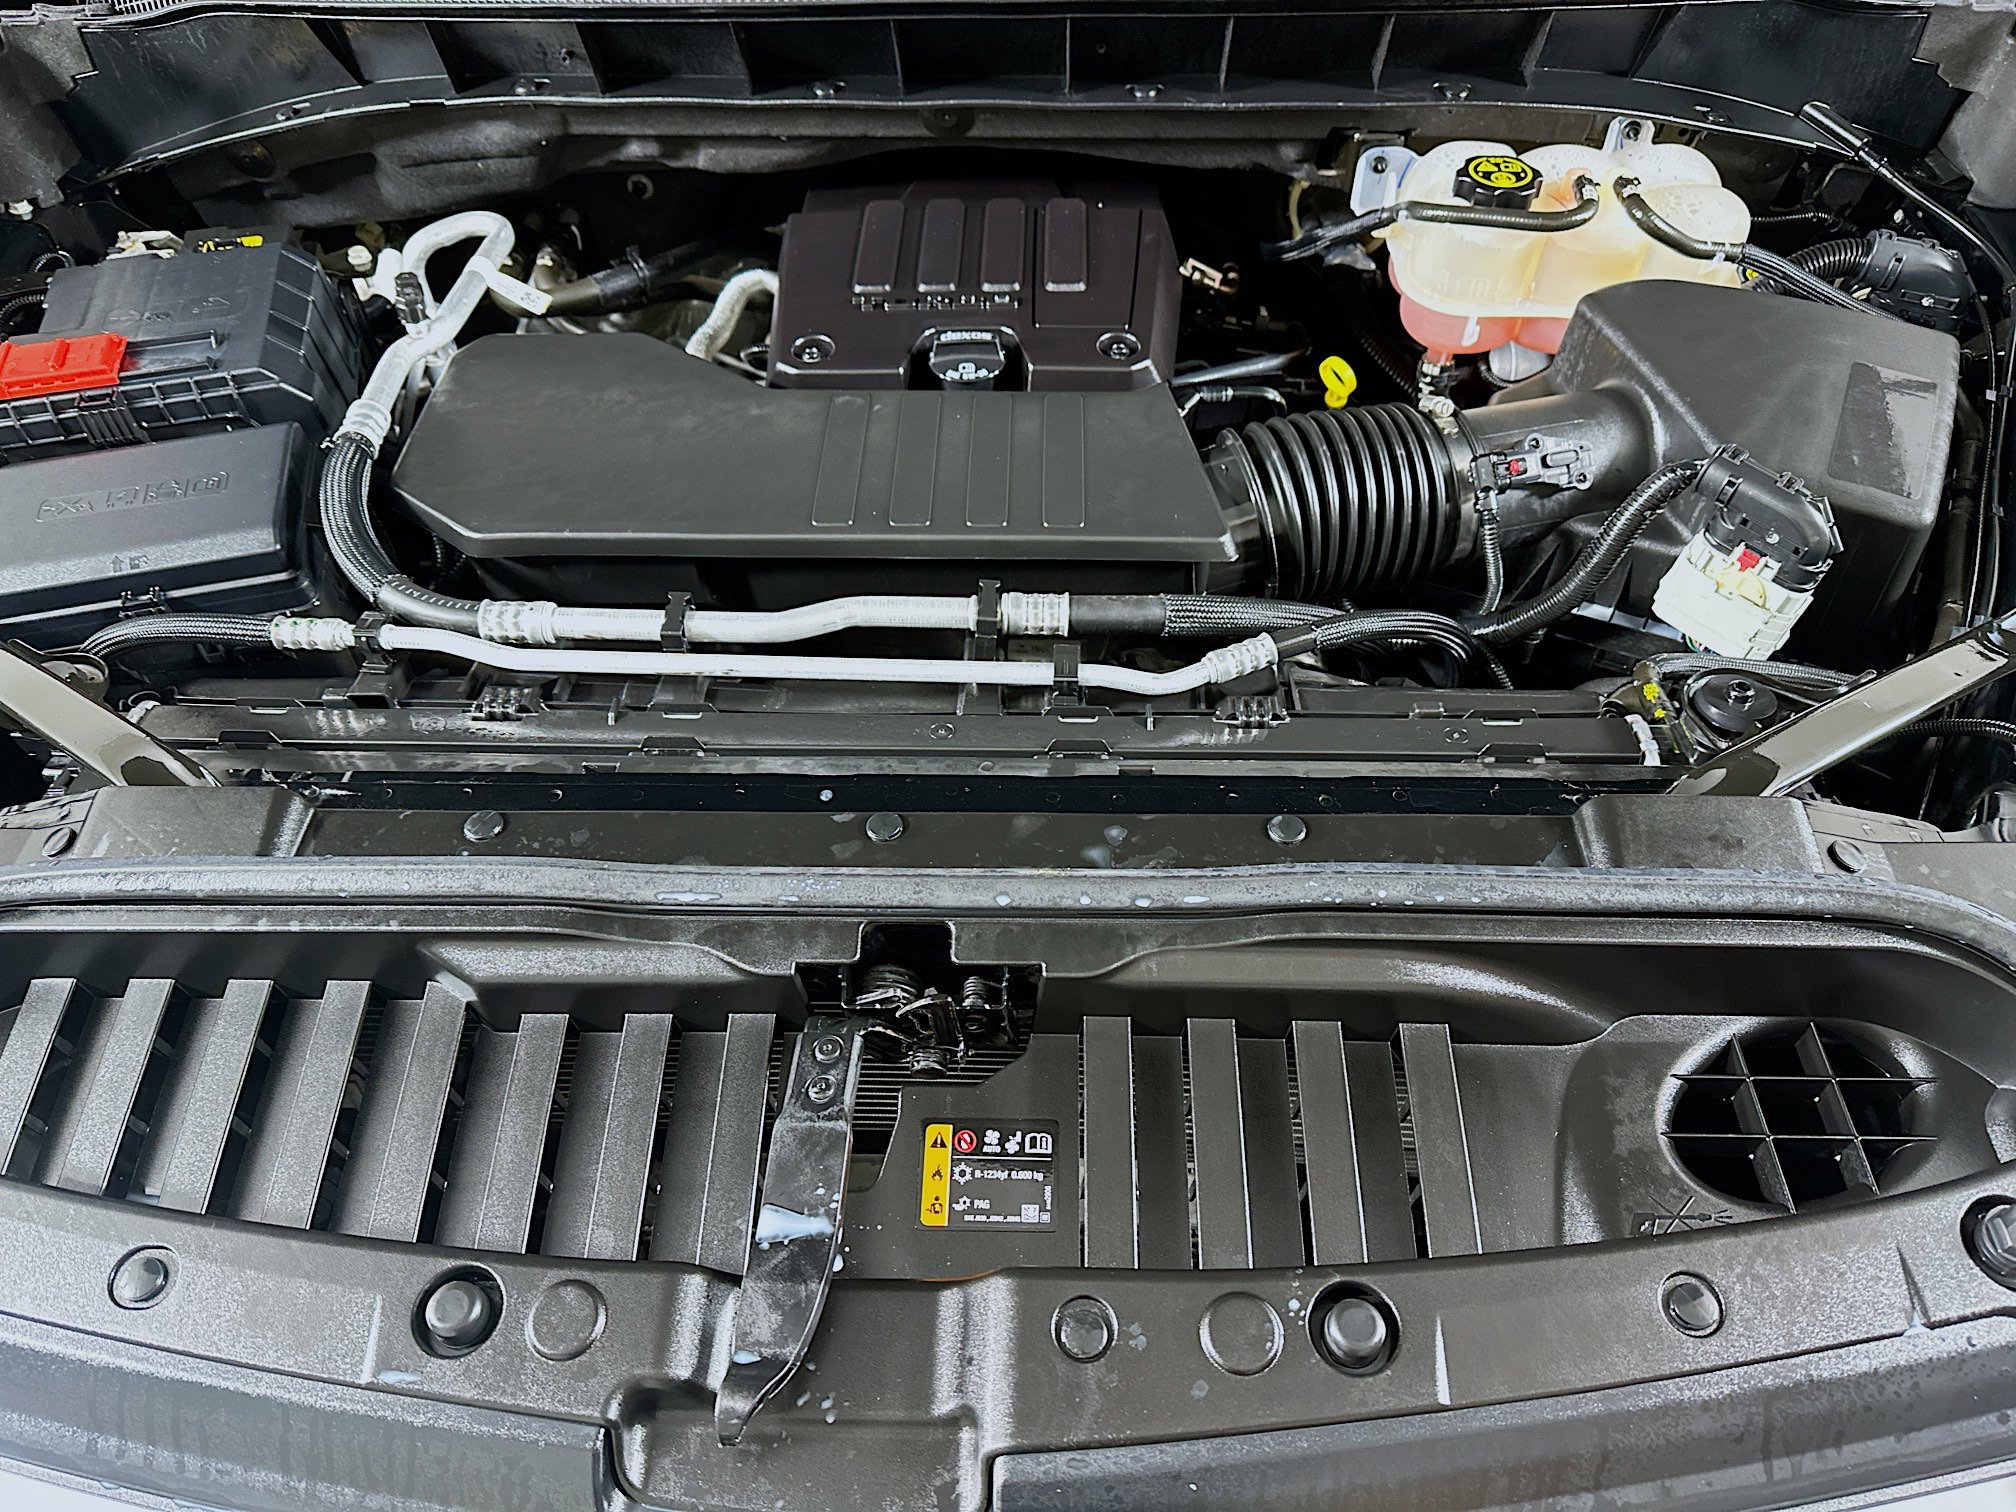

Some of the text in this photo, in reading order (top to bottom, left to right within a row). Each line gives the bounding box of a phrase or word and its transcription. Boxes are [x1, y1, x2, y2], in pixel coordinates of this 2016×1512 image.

[940, 331, 993, 342] dexos
[974, 1169, 1008, 1180] R-1234yf
[1033, 1170, 1044, 1181] kg
[974, 1199, 991, 1209] PAG
